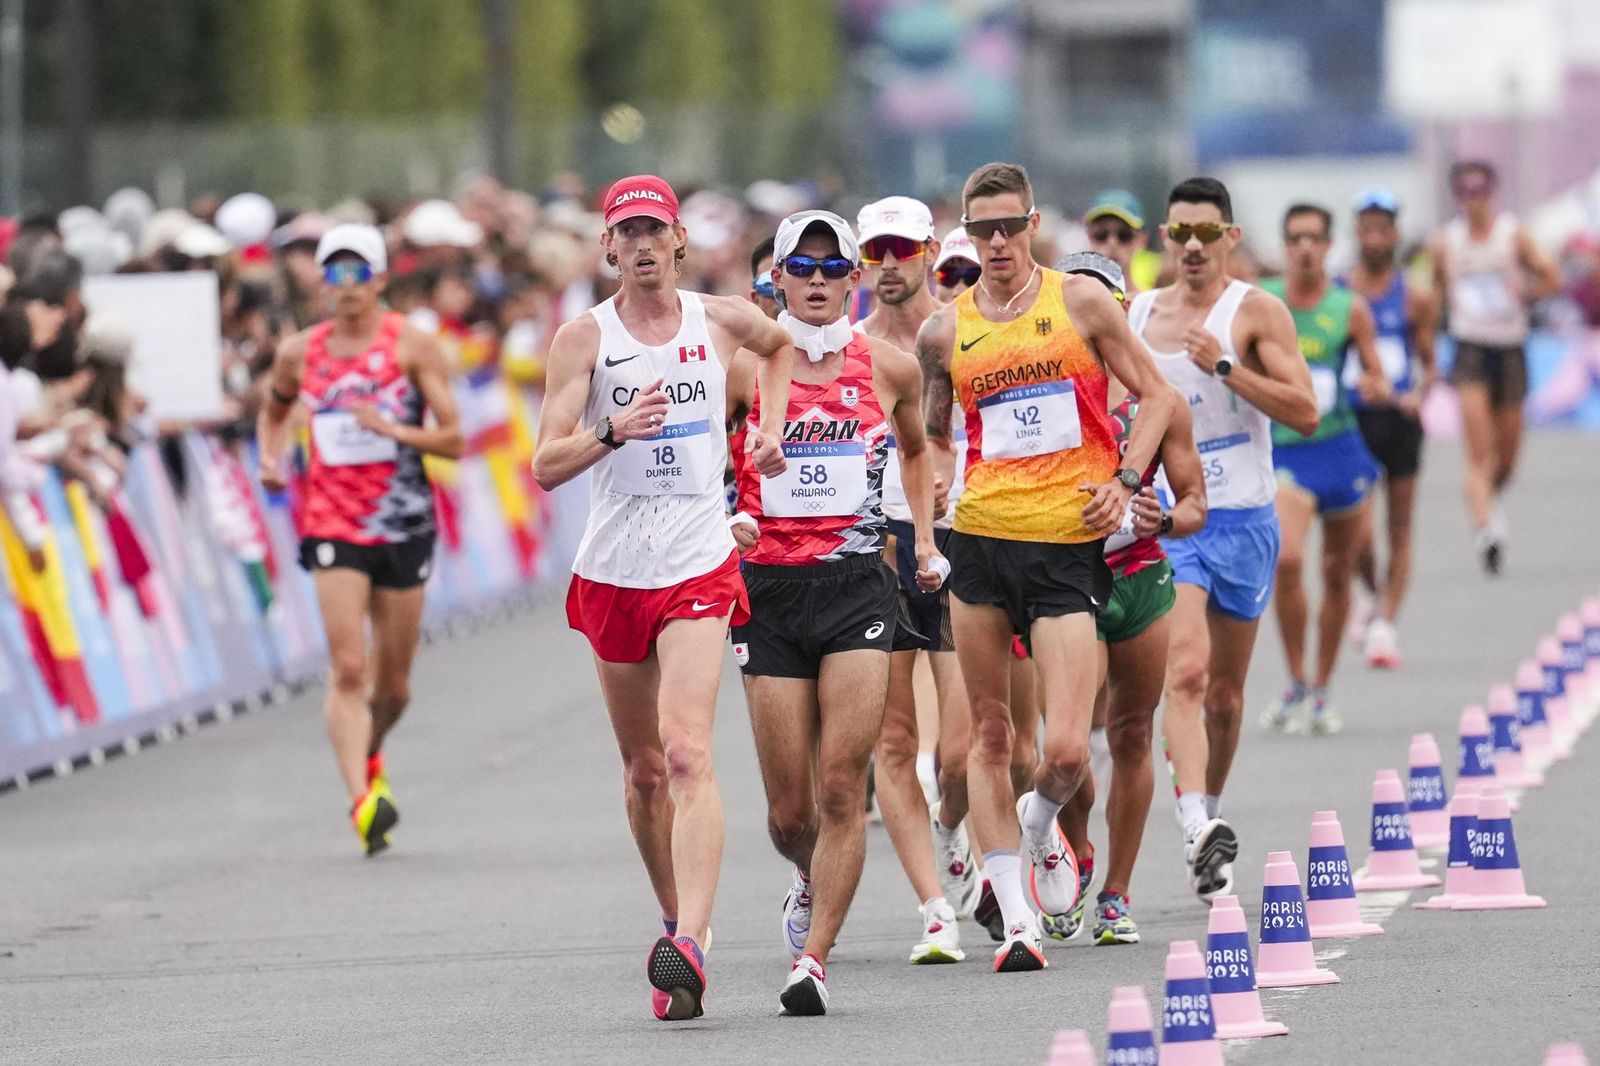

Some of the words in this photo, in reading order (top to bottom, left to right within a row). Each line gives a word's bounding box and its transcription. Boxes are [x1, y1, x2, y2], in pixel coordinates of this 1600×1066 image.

[615, 189, 664, 206] CANADA
[971, 359, 1063, 394] GERMANY
[612, 380, 706, 407] CAADA
[1013, 405, 1041, 426] 42
[1016, 426, 1043, 439] LINKE
[652, 445, 675, 466] 18
[814, 446, 838, 454] 2024
[645, 467, 682, 478] DUNFEE
[799, 464, 828, 485] 58
[791, 487, 837, 498] KAWANO
[1310, 859, 1348, 874] PARIS
[1310, 873, 1349, 888] 2024
[1263, 901, 1303, 915] PARIS
[1263, 915, 1304, 929] 2024
[1206, 948, 1248, 963] PARIS
[1206, 963, 1249, 979] 2024
